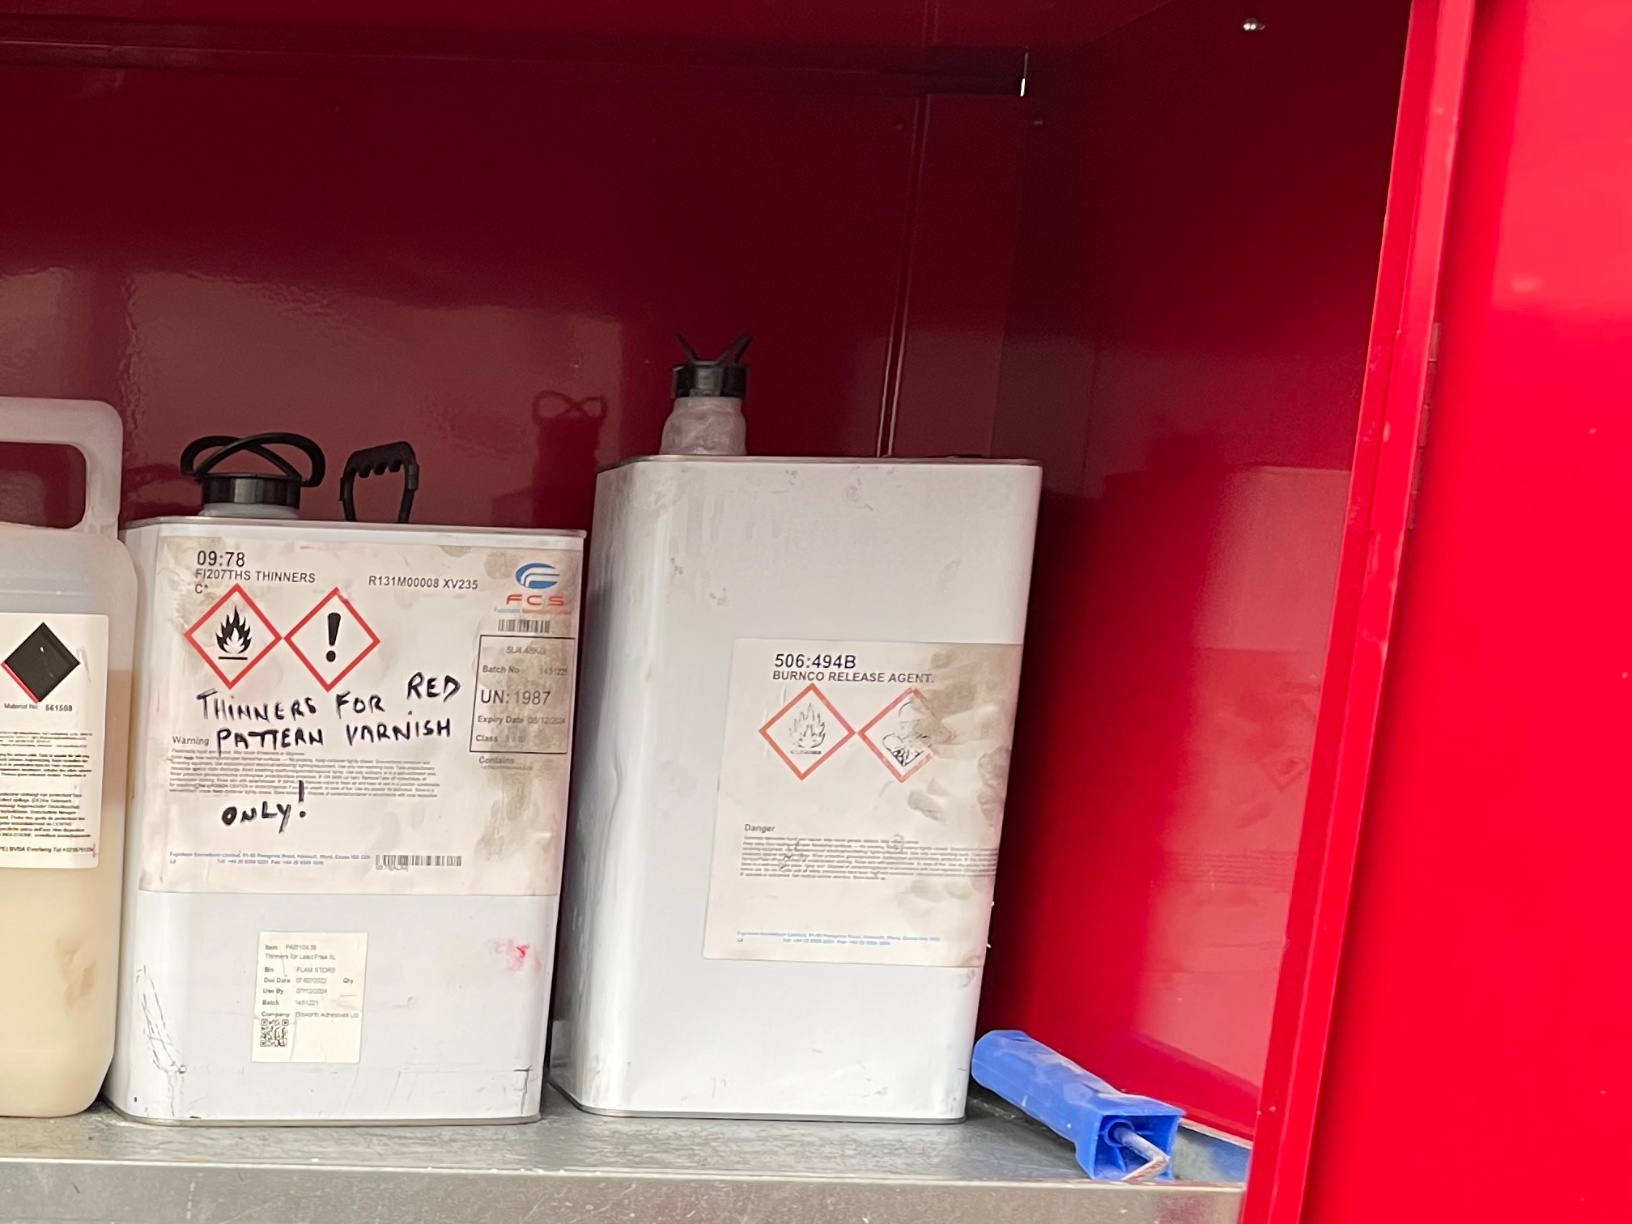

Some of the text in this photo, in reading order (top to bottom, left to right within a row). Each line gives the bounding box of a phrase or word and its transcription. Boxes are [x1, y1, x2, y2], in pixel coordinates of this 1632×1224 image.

[196, 550, 246, 568] 09:78
[255, 570, 316, 583] THINNERS
[368, 575, 440, 589] R131M00008
[442, 578, 479, 590] XV235
[774, 653, 857, 669] 506:494B
[772, 670, 825, 682] BURNCO
[828, 671, 885, 683] RELEASE
[335, 690, 386, 719] FOR
[406, 671, 461, 702] RED
[514, 690, 552, 706] 1987
[477, 715, 524, 725] Expiry Date
[171, 735, 210, 747] Warning
[217, 713, 451, 757] PATTERN VARNISH
[743, 824, 776, 834] Danger
